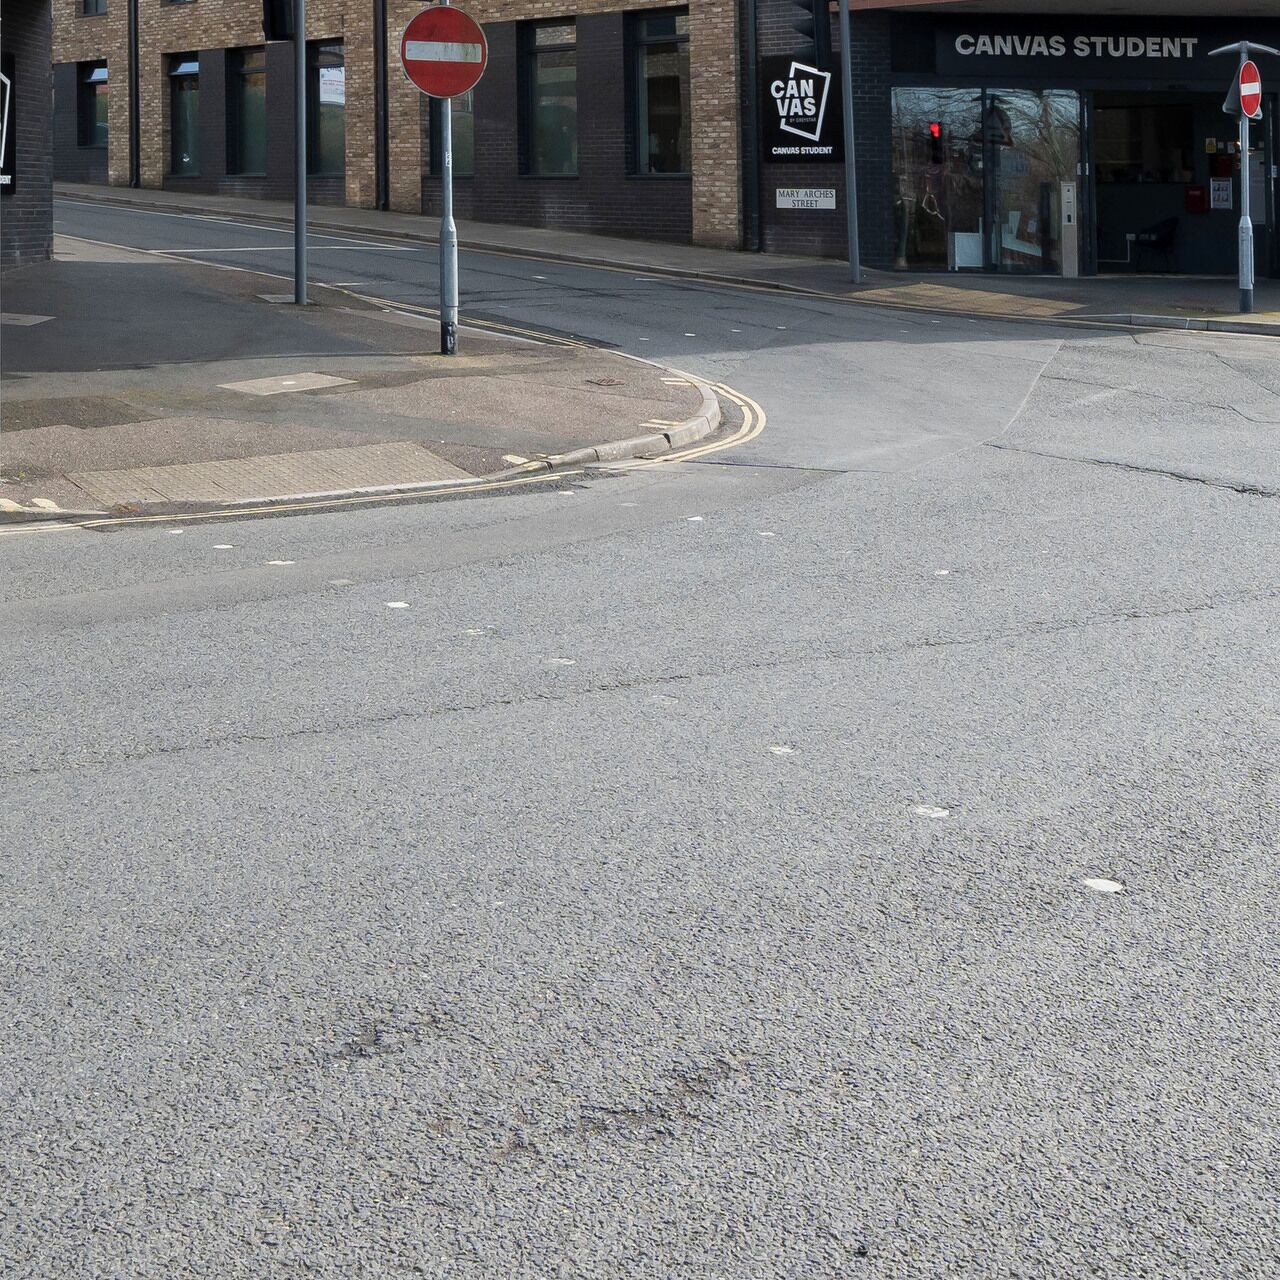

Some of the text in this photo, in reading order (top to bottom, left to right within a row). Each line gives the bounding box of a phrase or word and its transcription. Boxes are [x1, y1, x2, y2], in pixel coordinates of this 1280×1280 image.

[955, 34, 1198, 58] CANVAS STUDENT
[771, 79, 813, 98] CAN
[776, 98, 816, 116] VAS
[801, 146, 832, 154] STUDENT
[778, 190, 834, 199] MARY ARCHES
[791, 199, 819, 208] STREET
